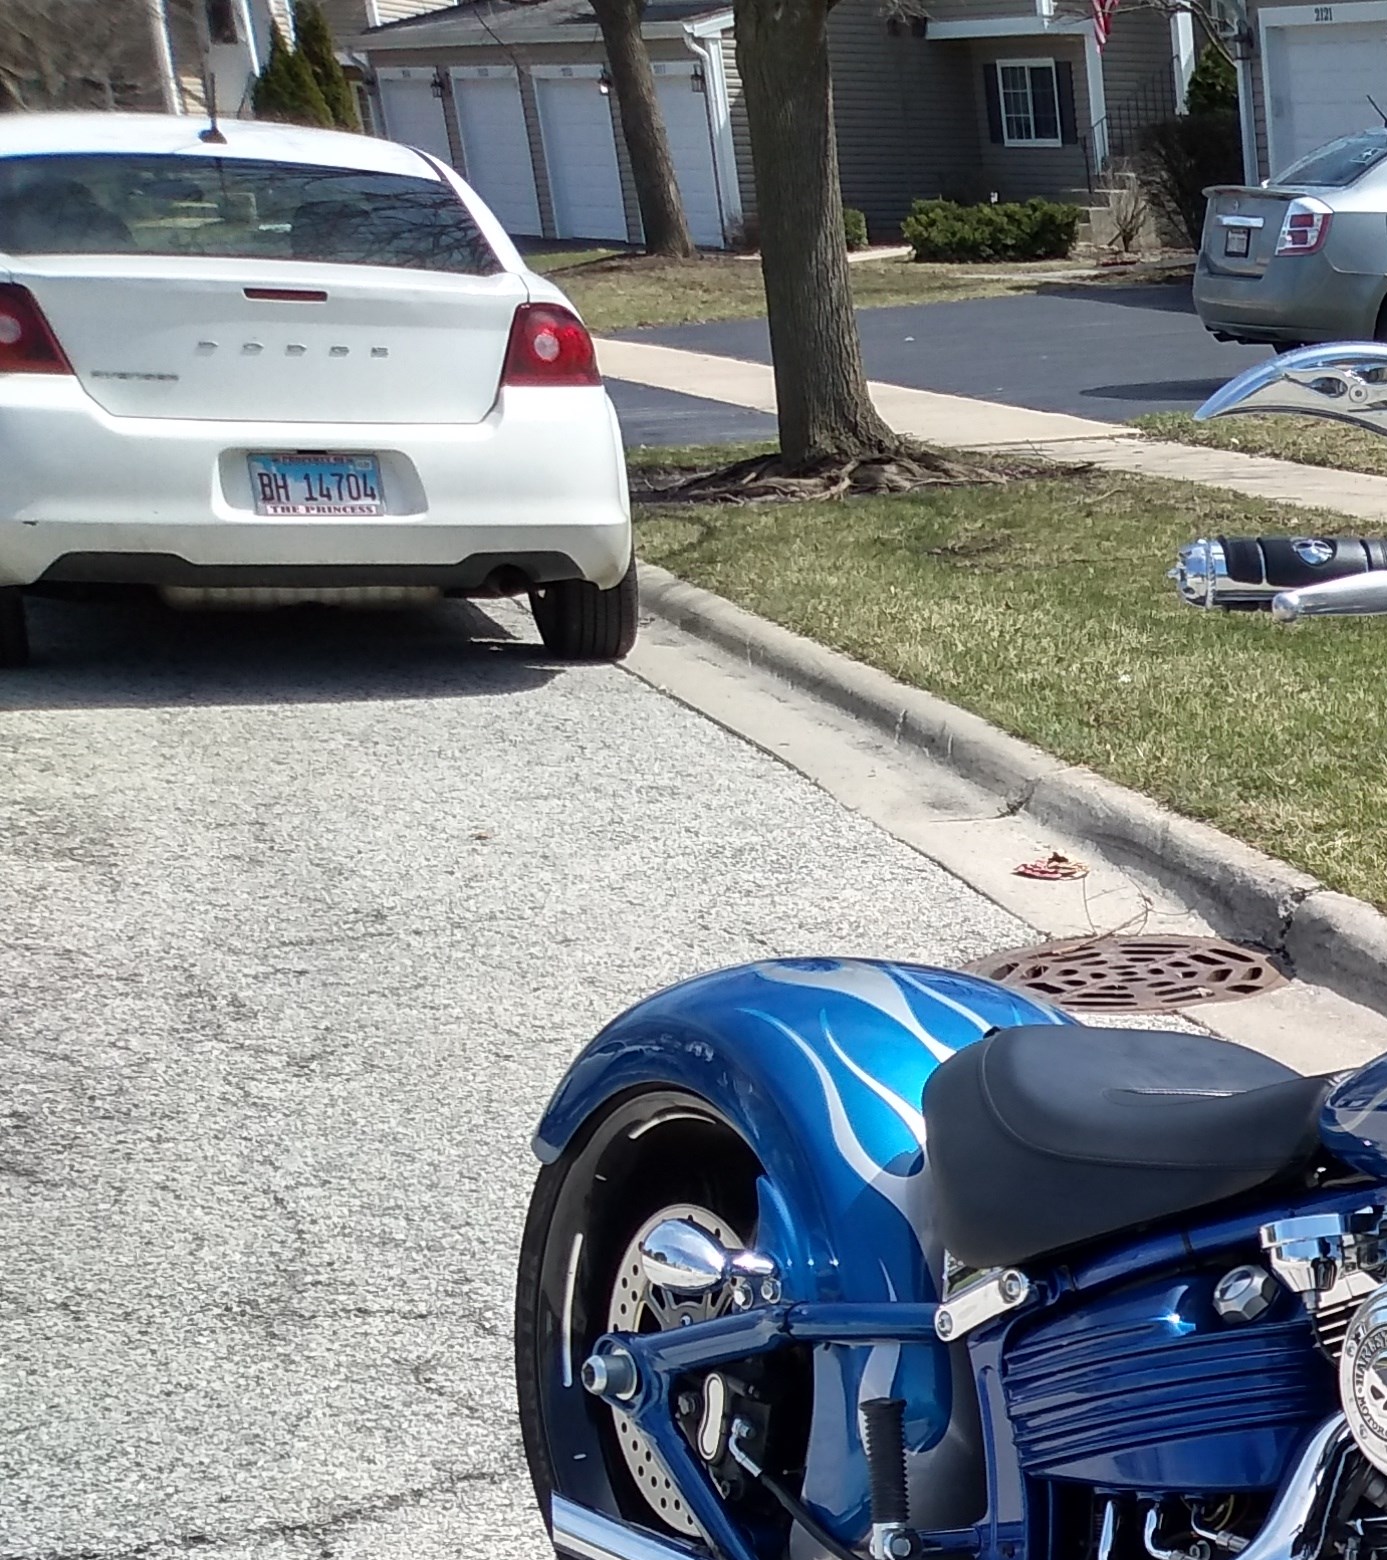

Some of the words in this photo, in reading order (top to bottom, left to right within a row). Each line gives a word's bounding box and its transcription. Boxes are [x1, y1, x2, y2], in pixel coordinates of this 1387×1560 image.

[1314, 7, 1333, 21] 2121
[198, 341, 389, 357] DODGE
[258, 472, 291, 502] BH
[303, 472, 377, 502] 14704
